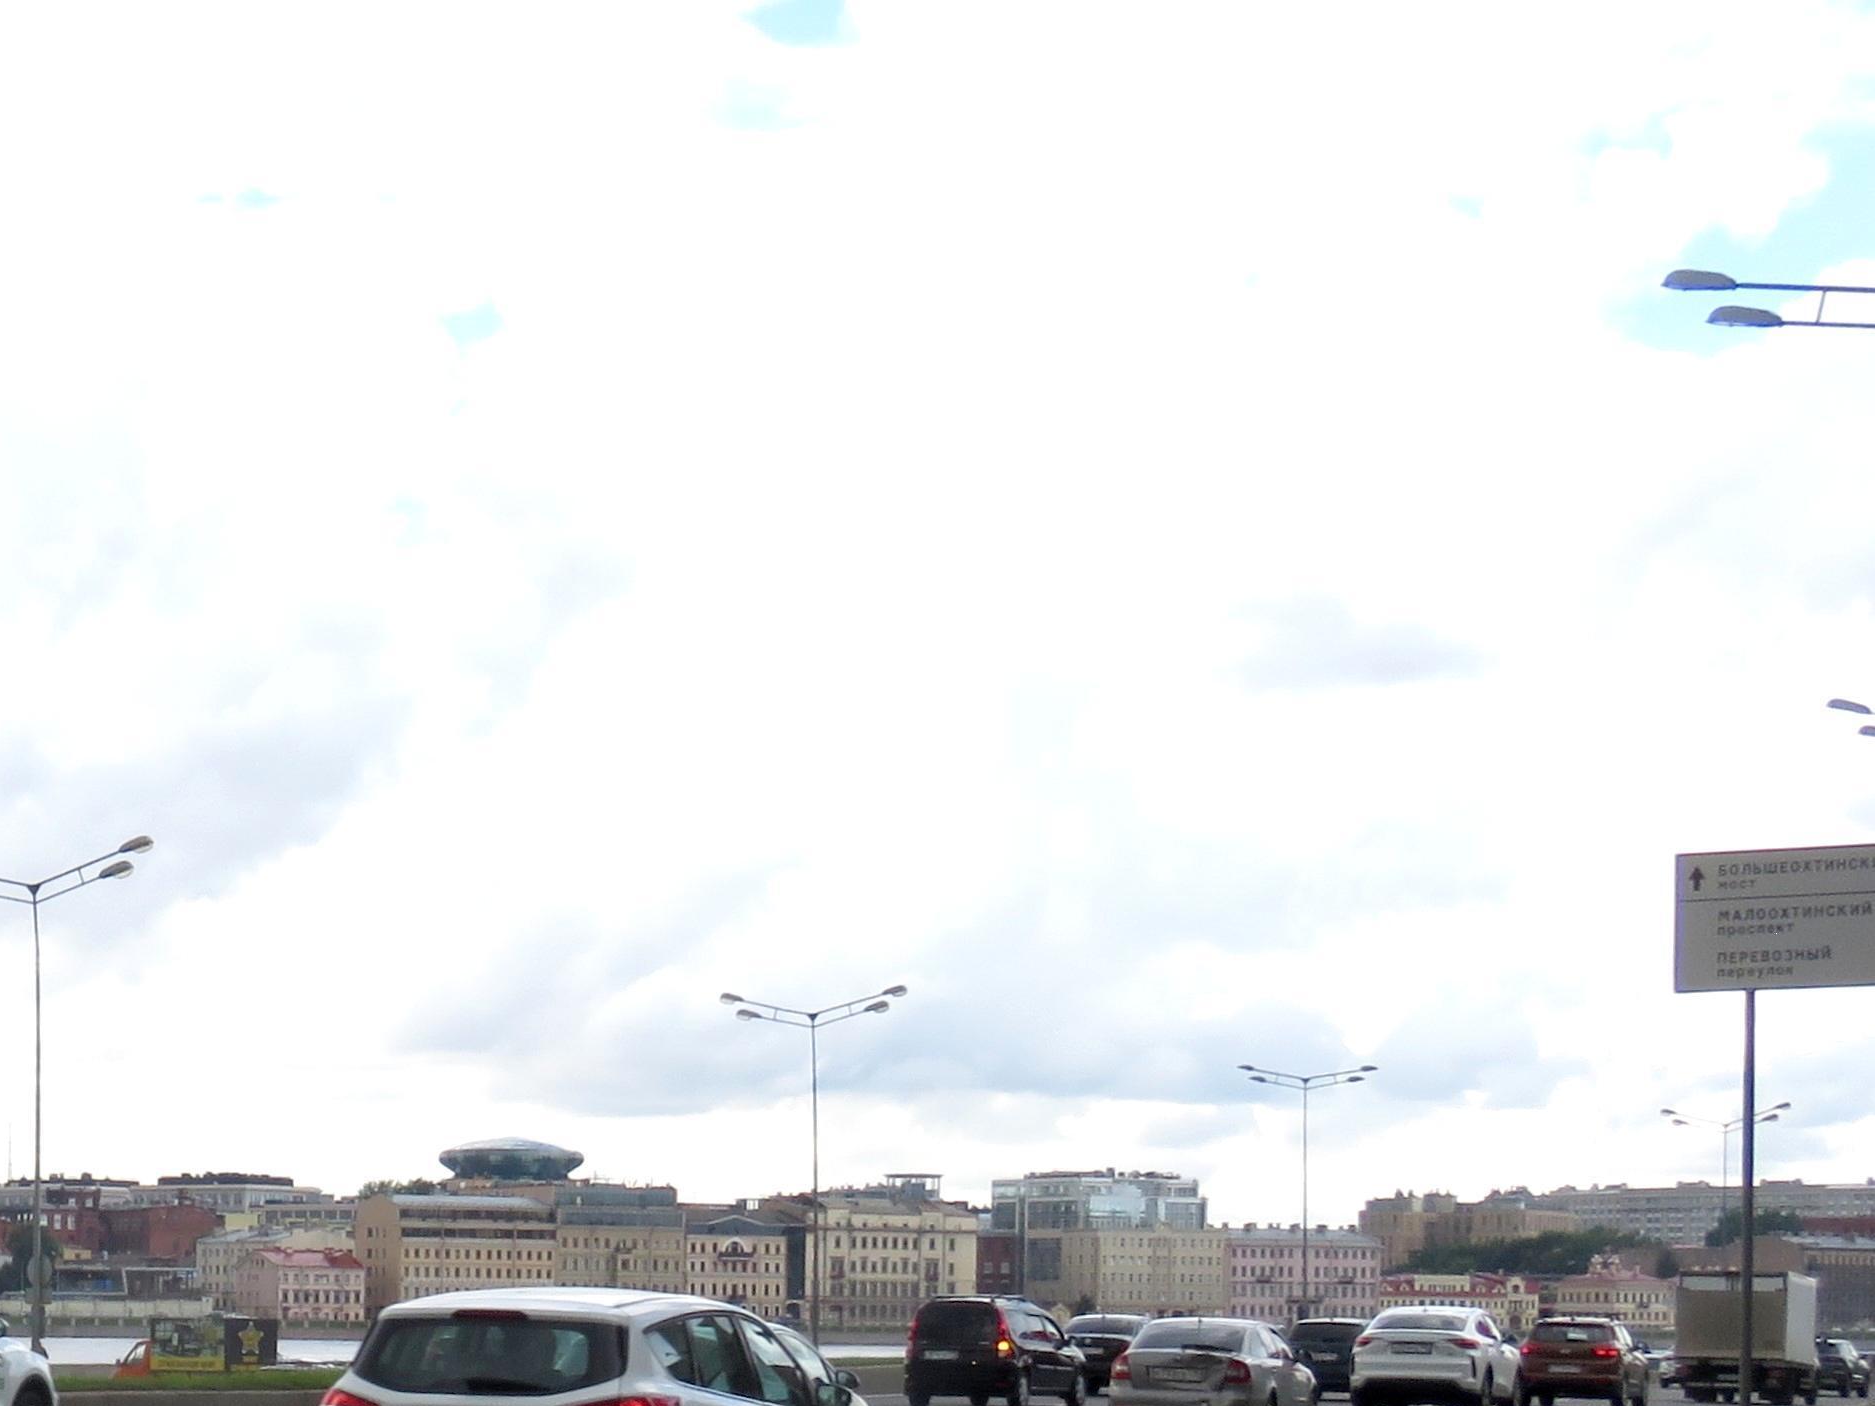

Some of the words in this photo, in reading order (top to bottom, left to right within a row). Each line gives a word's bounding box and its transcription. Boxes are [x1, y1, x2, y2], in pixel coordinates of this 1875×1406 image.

[1717, 879, 1756, 890] мост
[1718, 901, 1872, 921] МАЛООХТИНСКИЙ
[1717, 923, 1794, 937] проспект
[1717, 946, 1832, 964] ПЕРЕВОЗНЫЙ
[1717, 966, 1793, 979] переулок
